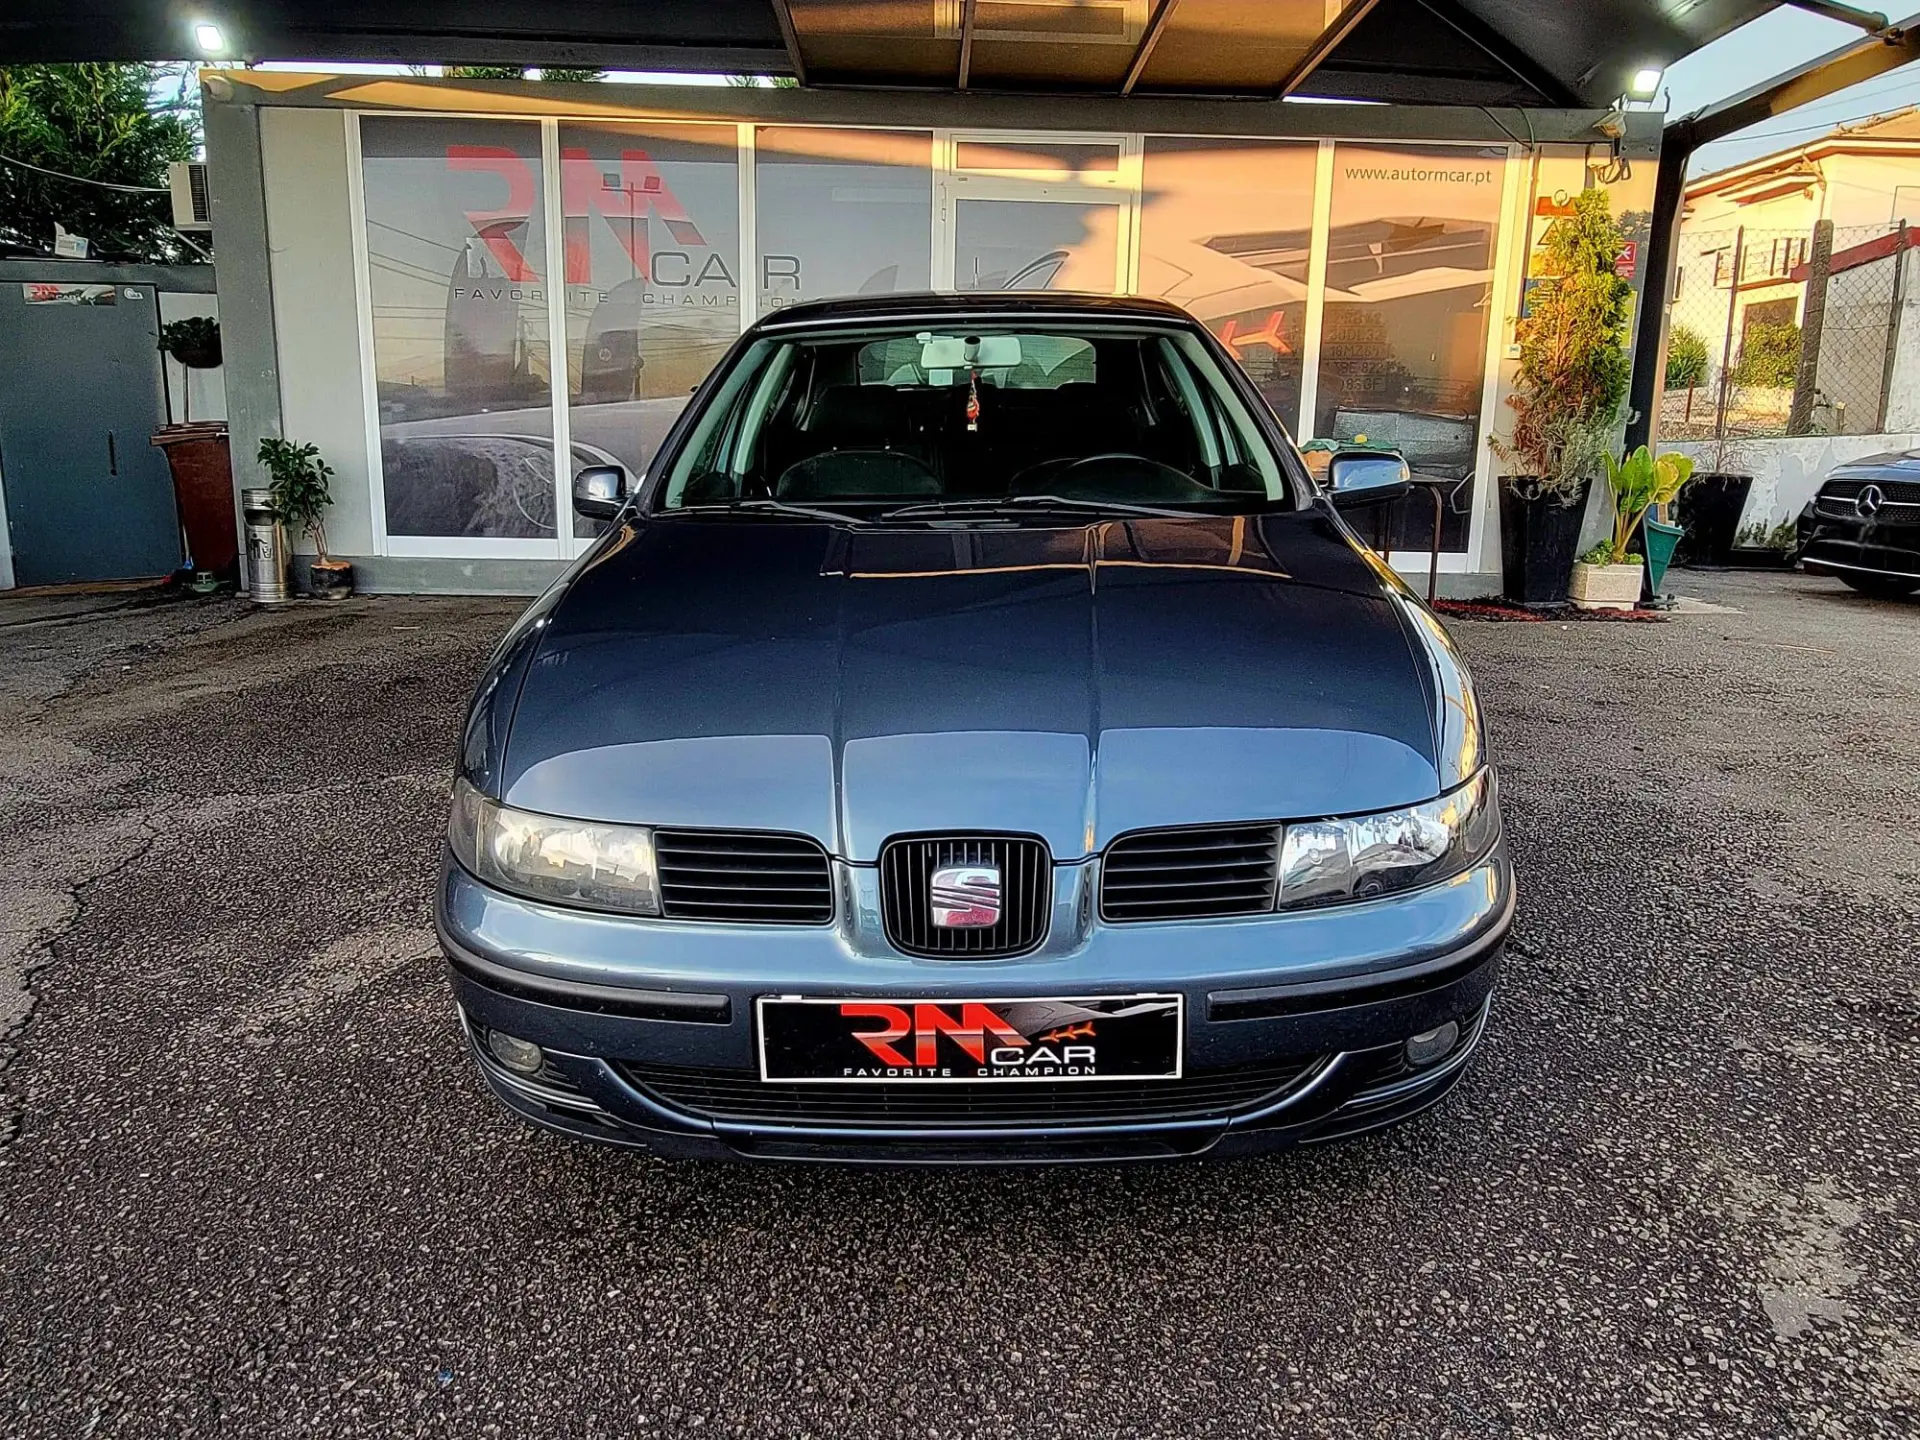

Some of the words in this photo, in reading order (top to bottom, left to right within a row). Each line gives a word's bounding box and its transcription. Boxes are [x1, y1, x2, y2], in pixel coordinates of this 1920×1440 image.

[1345, 167, 1492, 185] www.autormcar.pt
[651, 251, 801, 290] CAR
[454, 288, 609, 303] FAVORITE
[840, 1003, 1032, 1066] RM
[990, 1046, 1096, 1066] CAR
[843, 1067, 952, 1077] FAVORITE
[976, 1065, 1096, 1077] CHAMPION
